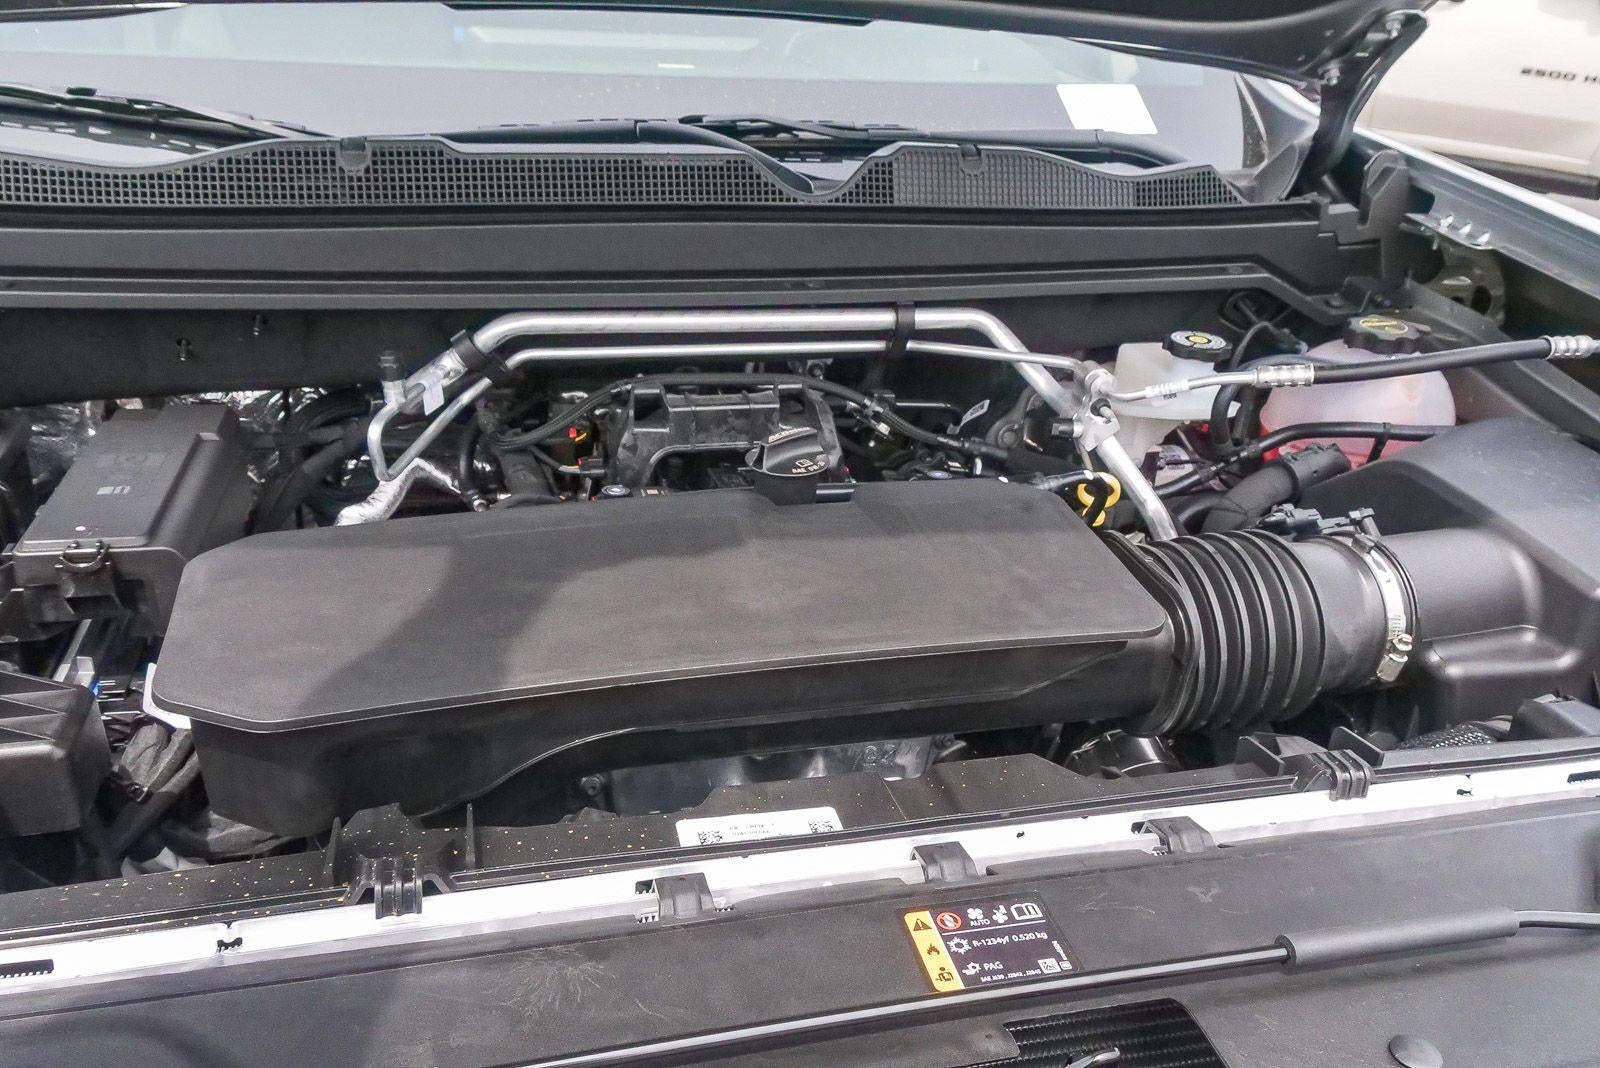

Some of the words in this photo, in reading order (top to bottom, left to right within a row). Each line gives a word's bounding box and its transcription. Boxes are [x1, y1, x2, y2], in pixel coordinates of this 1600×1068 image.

[1521, 68, 1576, 81] 2500
[972, 936, 1009, 947] R-1234yf
[1012, 933, 1035, 941] 0.520
[983, 962, 1003, 970] PAG
